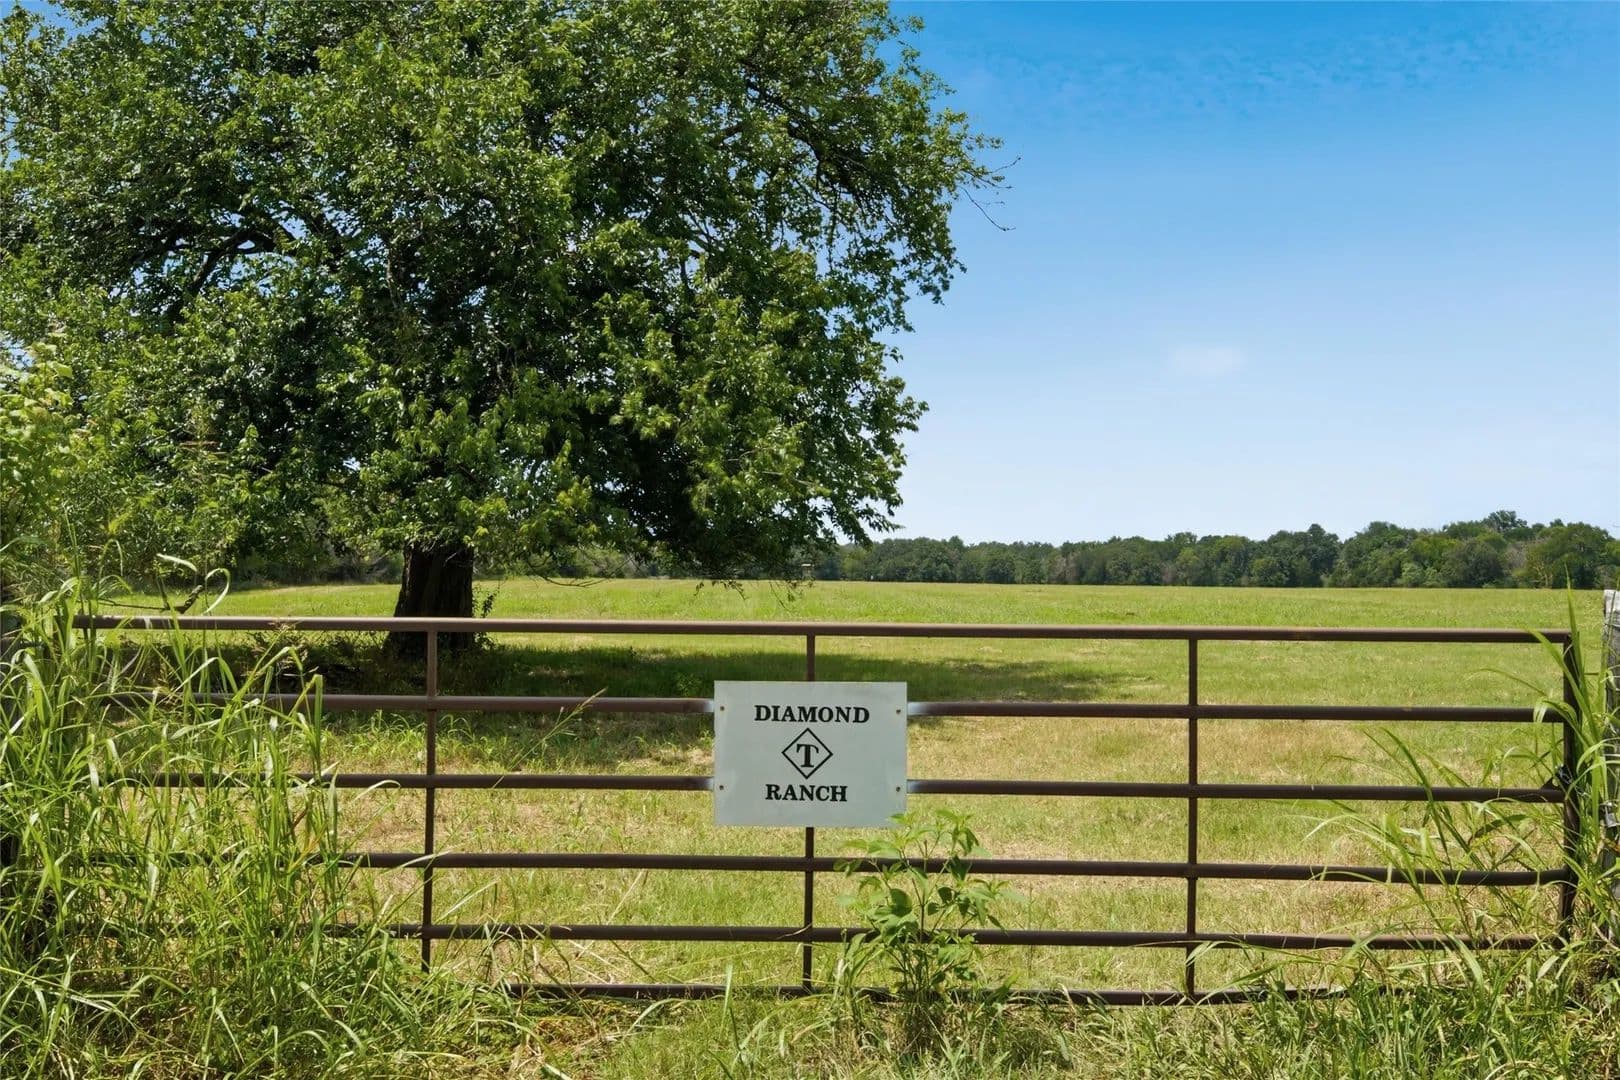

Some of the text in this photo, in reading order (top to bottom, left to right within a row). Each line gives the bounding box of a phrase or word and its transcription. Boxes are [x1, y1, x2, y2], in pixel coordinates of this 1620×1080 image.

[754, 704, 870, 723] DIAMOND
[796, 743, 820, 769] T
[765, 783, 848, 802] RANCH
